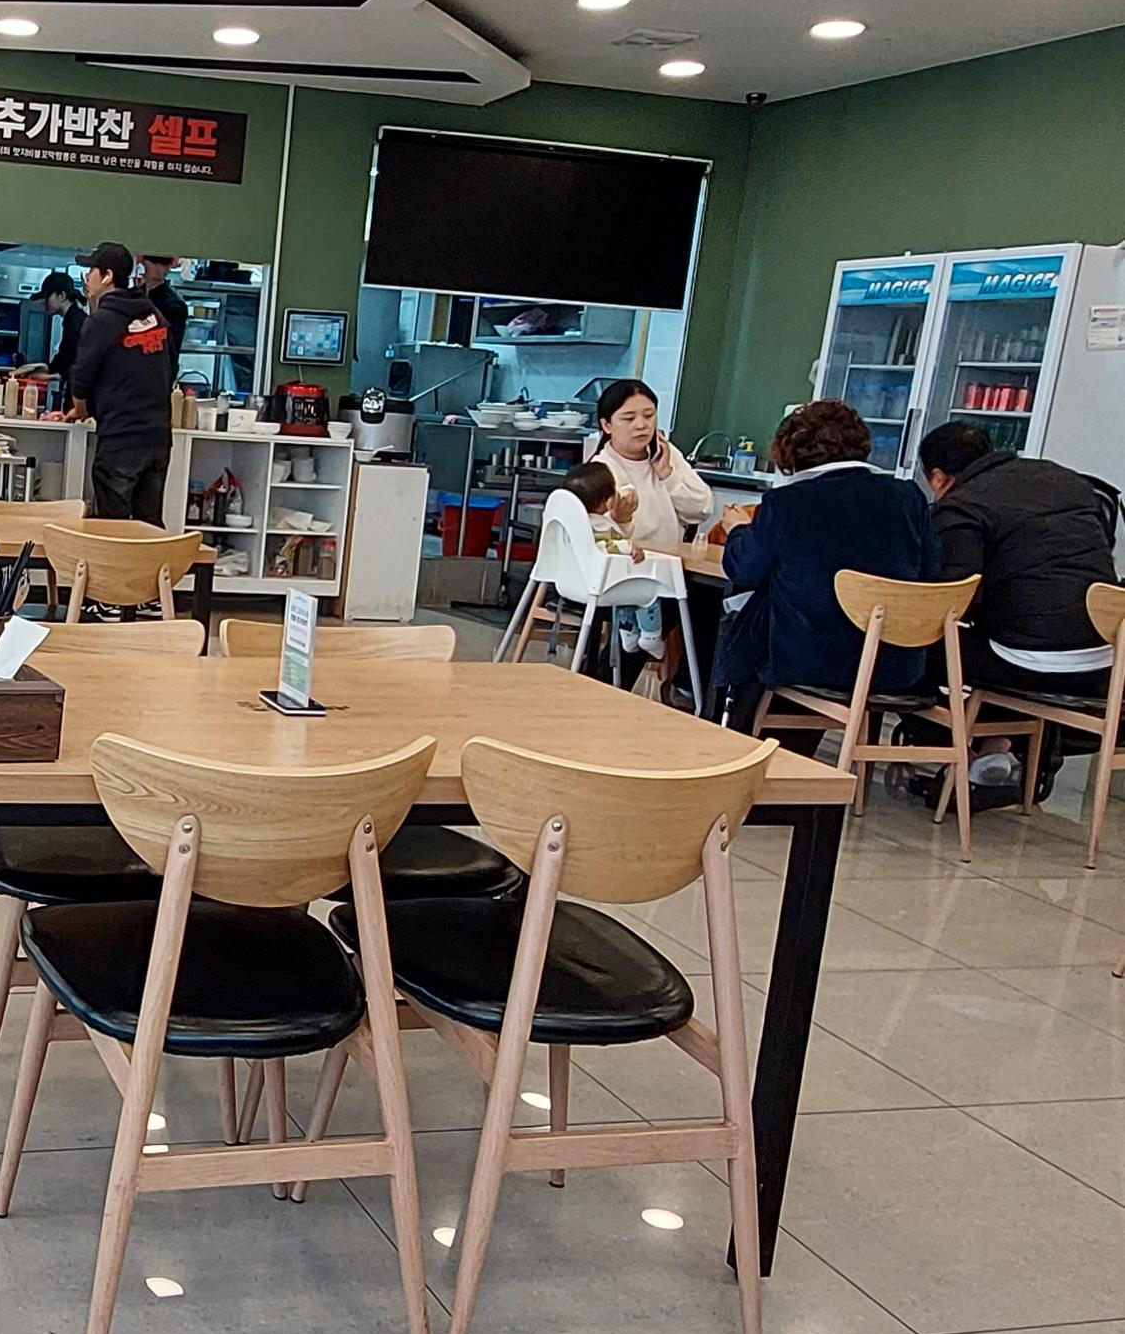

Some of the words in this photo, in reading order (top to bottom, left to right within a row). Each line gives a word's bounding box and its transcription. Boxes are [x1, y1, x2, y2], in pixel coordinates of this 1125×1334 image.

[147, 113, 218, 158] 셀프
[79, 153, 101, 164] 절대로
[102, 156, 118, 166] 남은
[119, 158, 141, 169] 반찬을
[143, 159, 166, 171] 재활용
[167, 162, 182, 173] 하지
